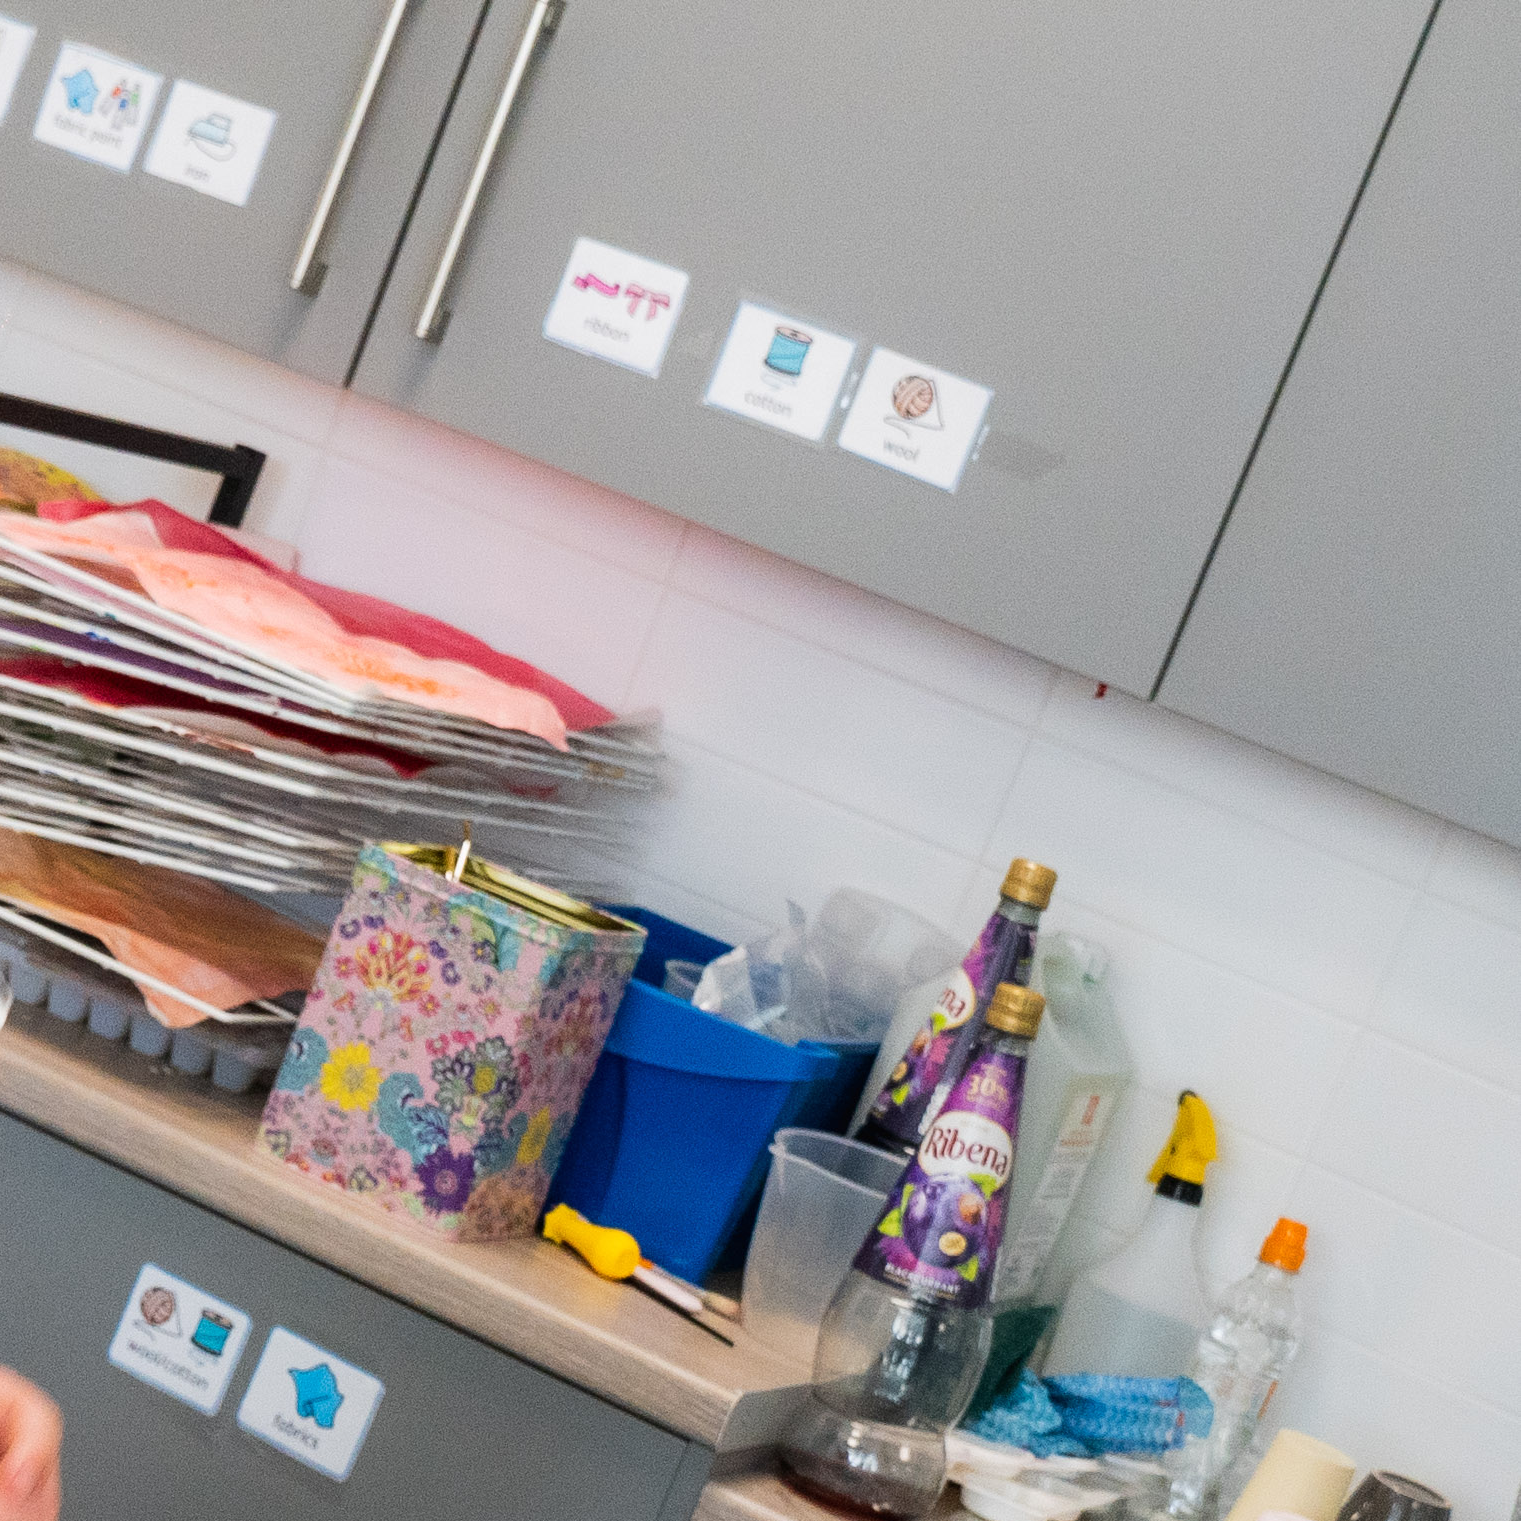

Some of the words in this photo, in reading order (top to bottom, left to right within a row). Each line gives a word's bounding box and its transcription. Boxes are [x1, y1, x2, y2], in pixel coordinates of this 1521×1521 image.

[583, 316, 631, 343] ribbon
[744, 391, 793, 417] cotton
[883, 439, 920, 463] wool
[924, 1125, 1009, 1179] Ribena
